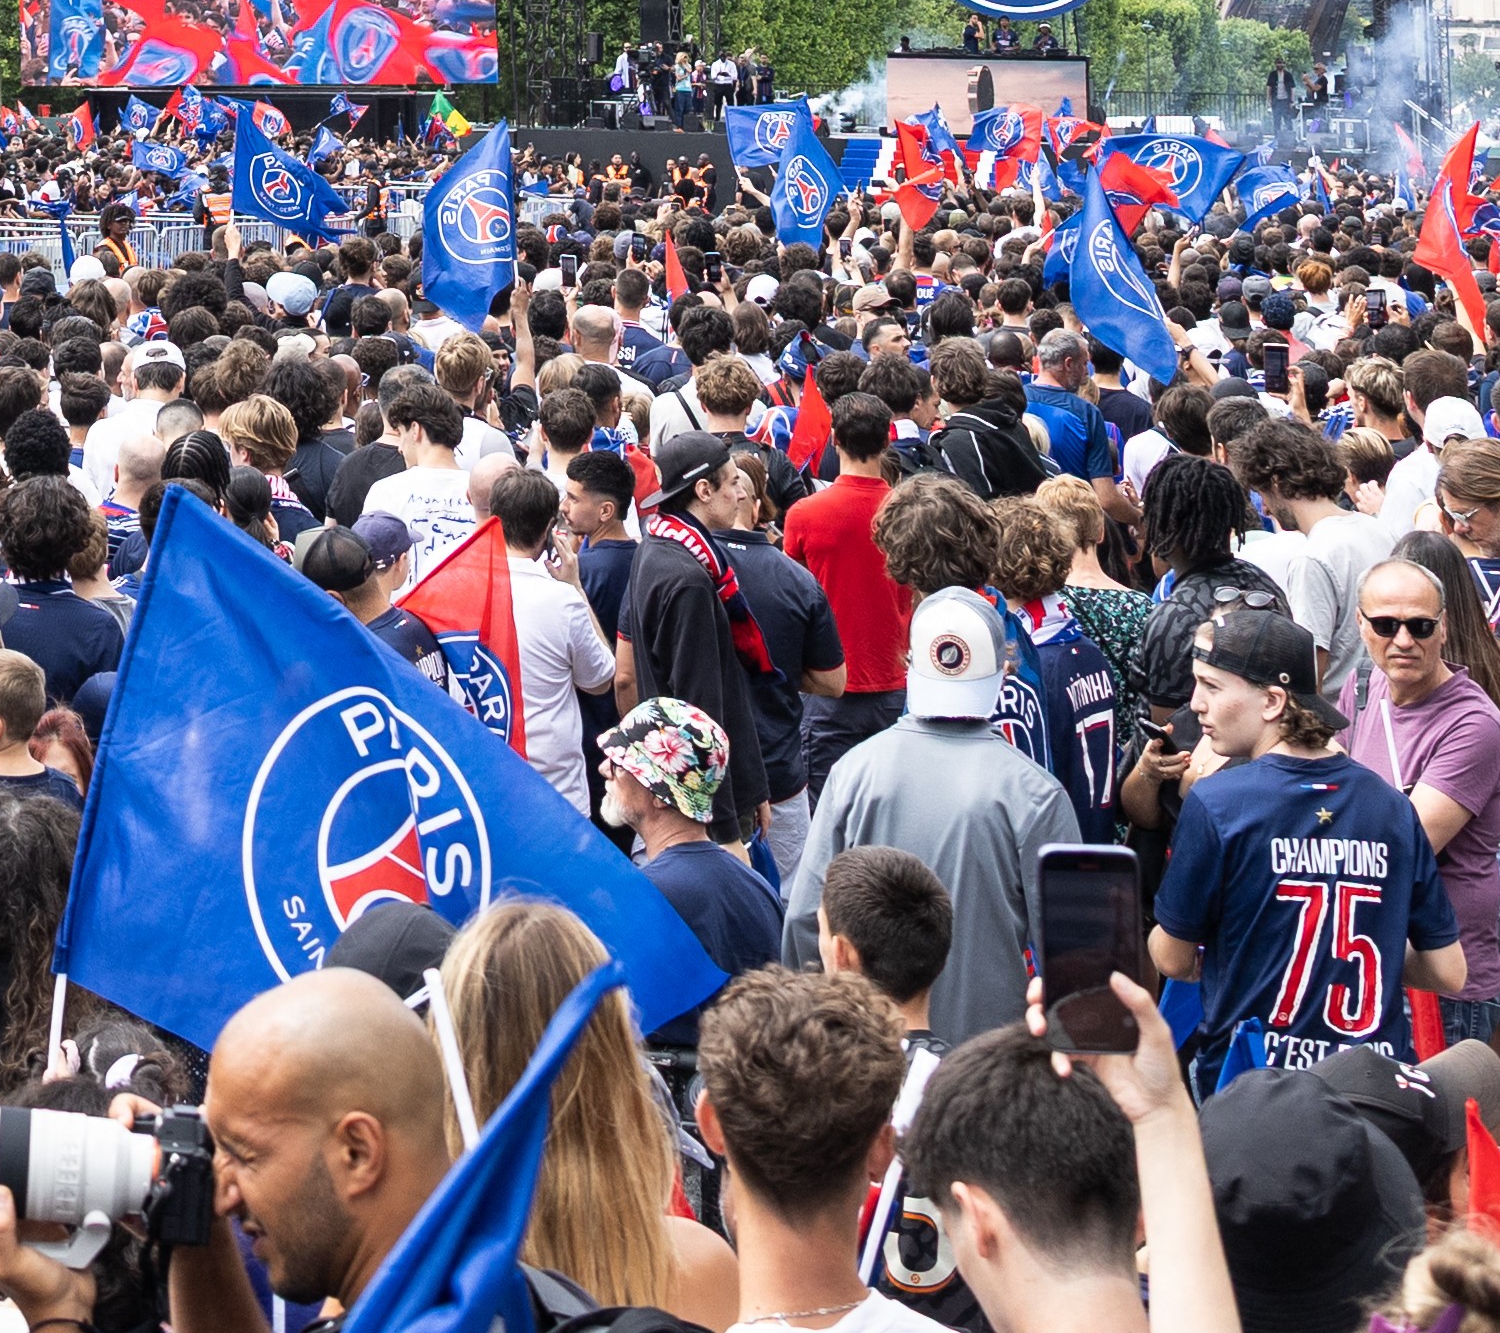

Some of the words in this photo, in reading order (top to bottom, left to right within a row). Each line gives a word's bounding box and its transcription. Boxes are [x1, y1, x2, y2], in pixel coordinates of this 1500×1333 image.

[994, 685, 1036, 729] RIS
[1076, 709, 1114, 809] 17
[1271, 837, 1388, 879] CHAMPIONS
[1268, 879, 1383, 1038] 75
[1264, 1031, 1331, 1071] C'EST
